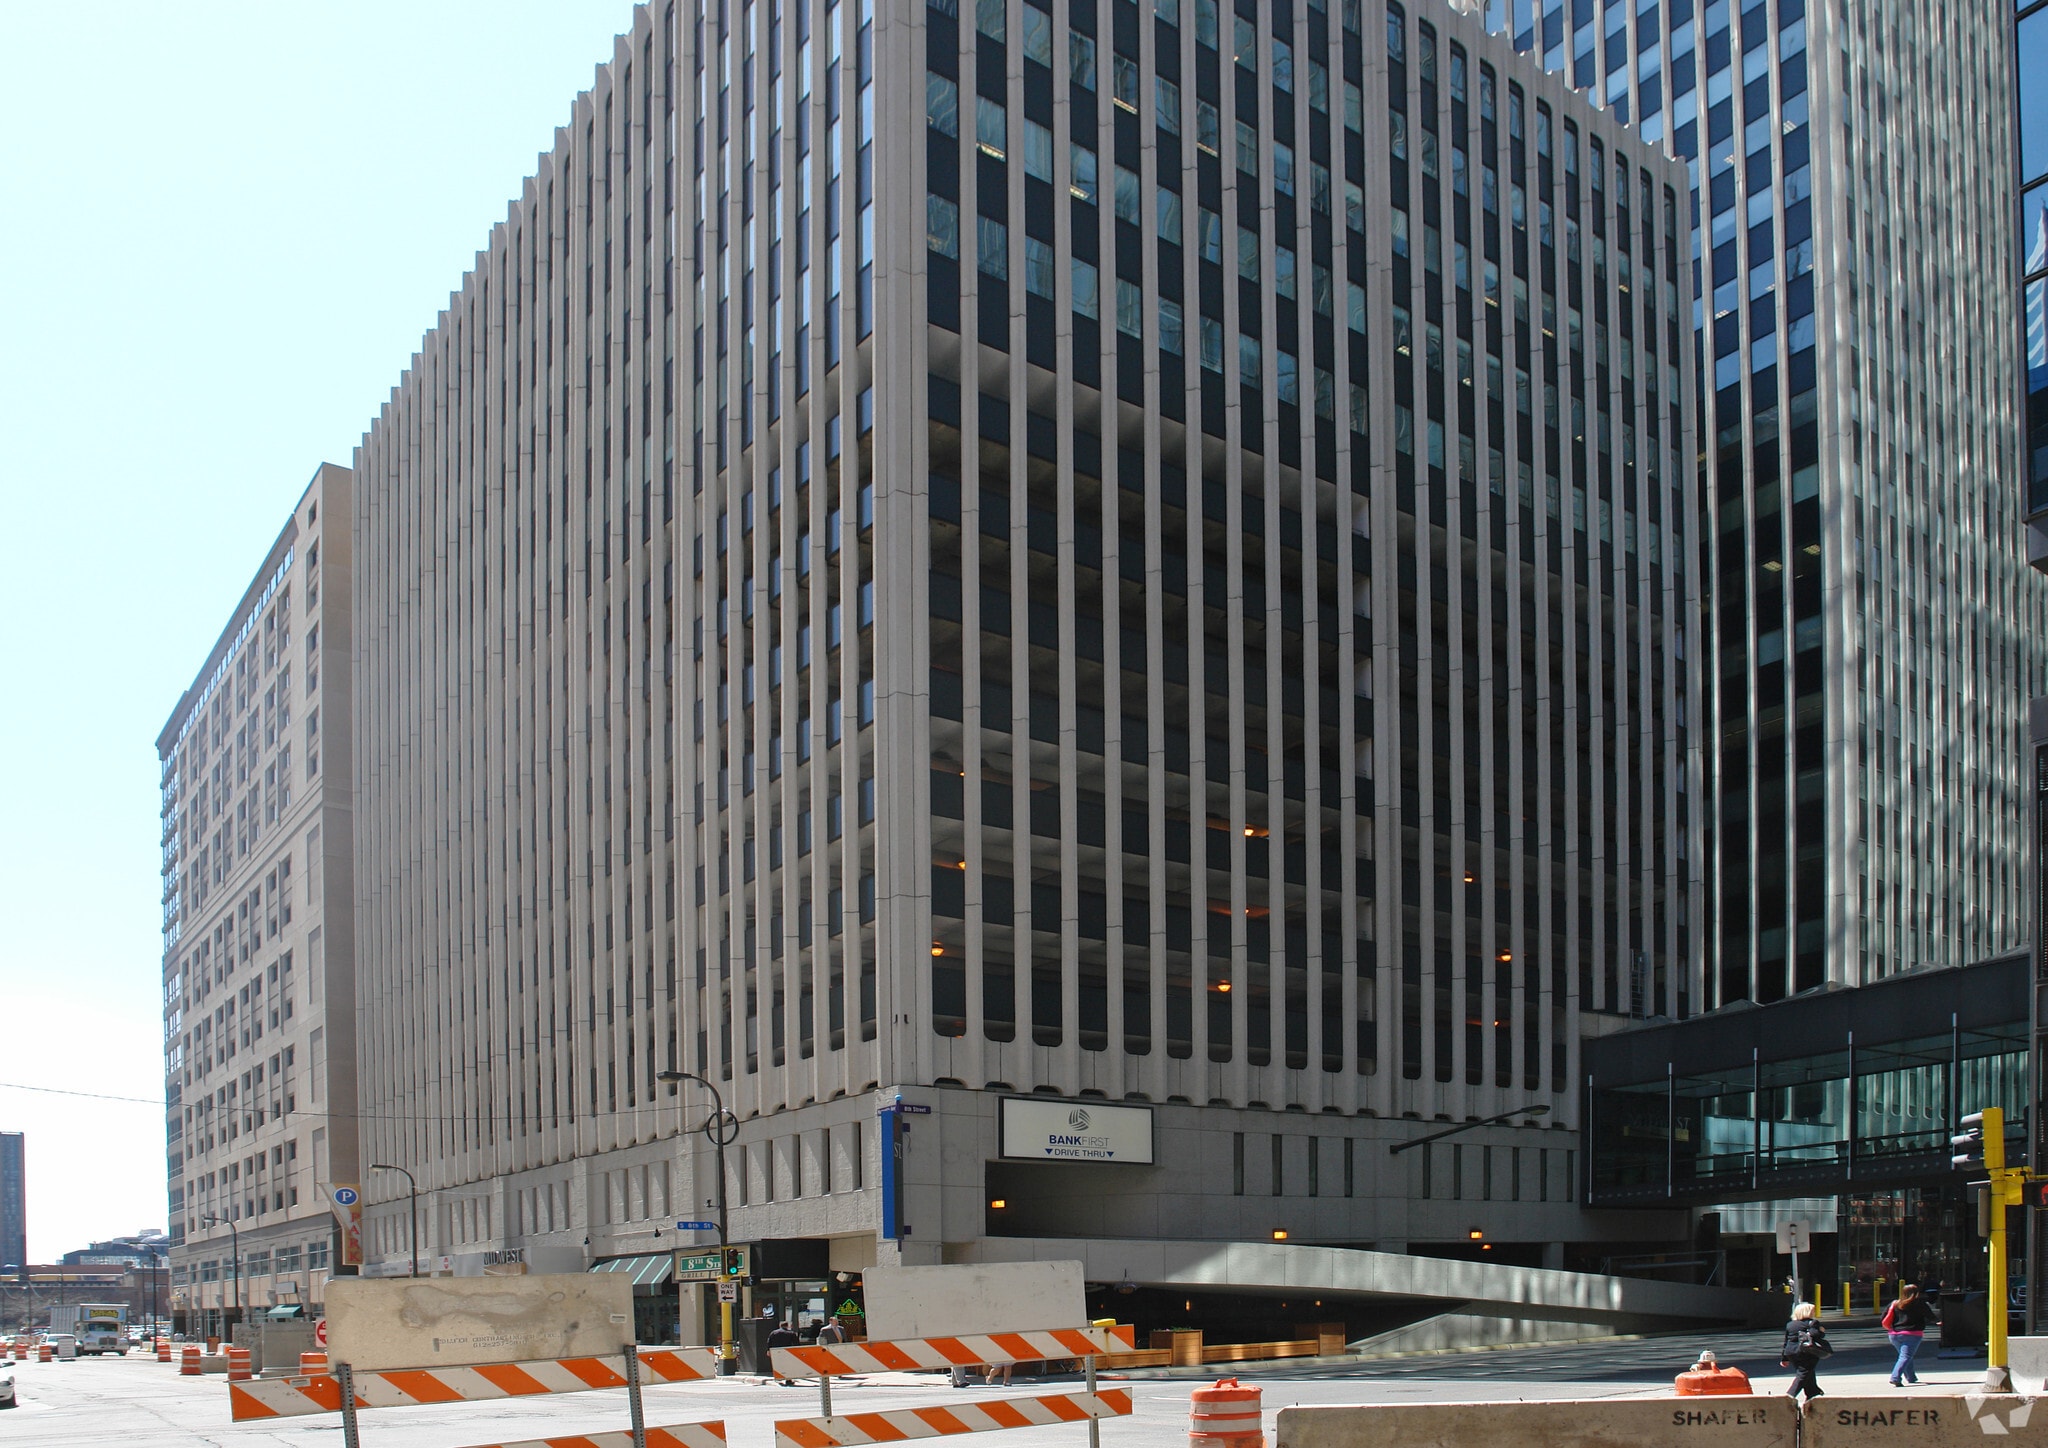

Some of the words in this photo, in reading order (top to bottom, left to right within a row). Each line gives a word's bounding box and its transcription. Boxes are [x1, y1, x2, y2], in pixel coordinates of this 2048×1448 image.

[1049, 1134, 1110, 1147] BANKFIRST
[1054, 1148, 1080, 1157] DRIVE
[1082, 1149, 1106, 1158] THRU
[342, 1191, 352, 1202] P
[350, 1212, 361, 1262] PARK
[484, 1248, 524, 1265] MIDWEST
[1672, 1409, 1767, 1426] SHAFER
[1837, 1409, 1940, 1426] SHAFER
